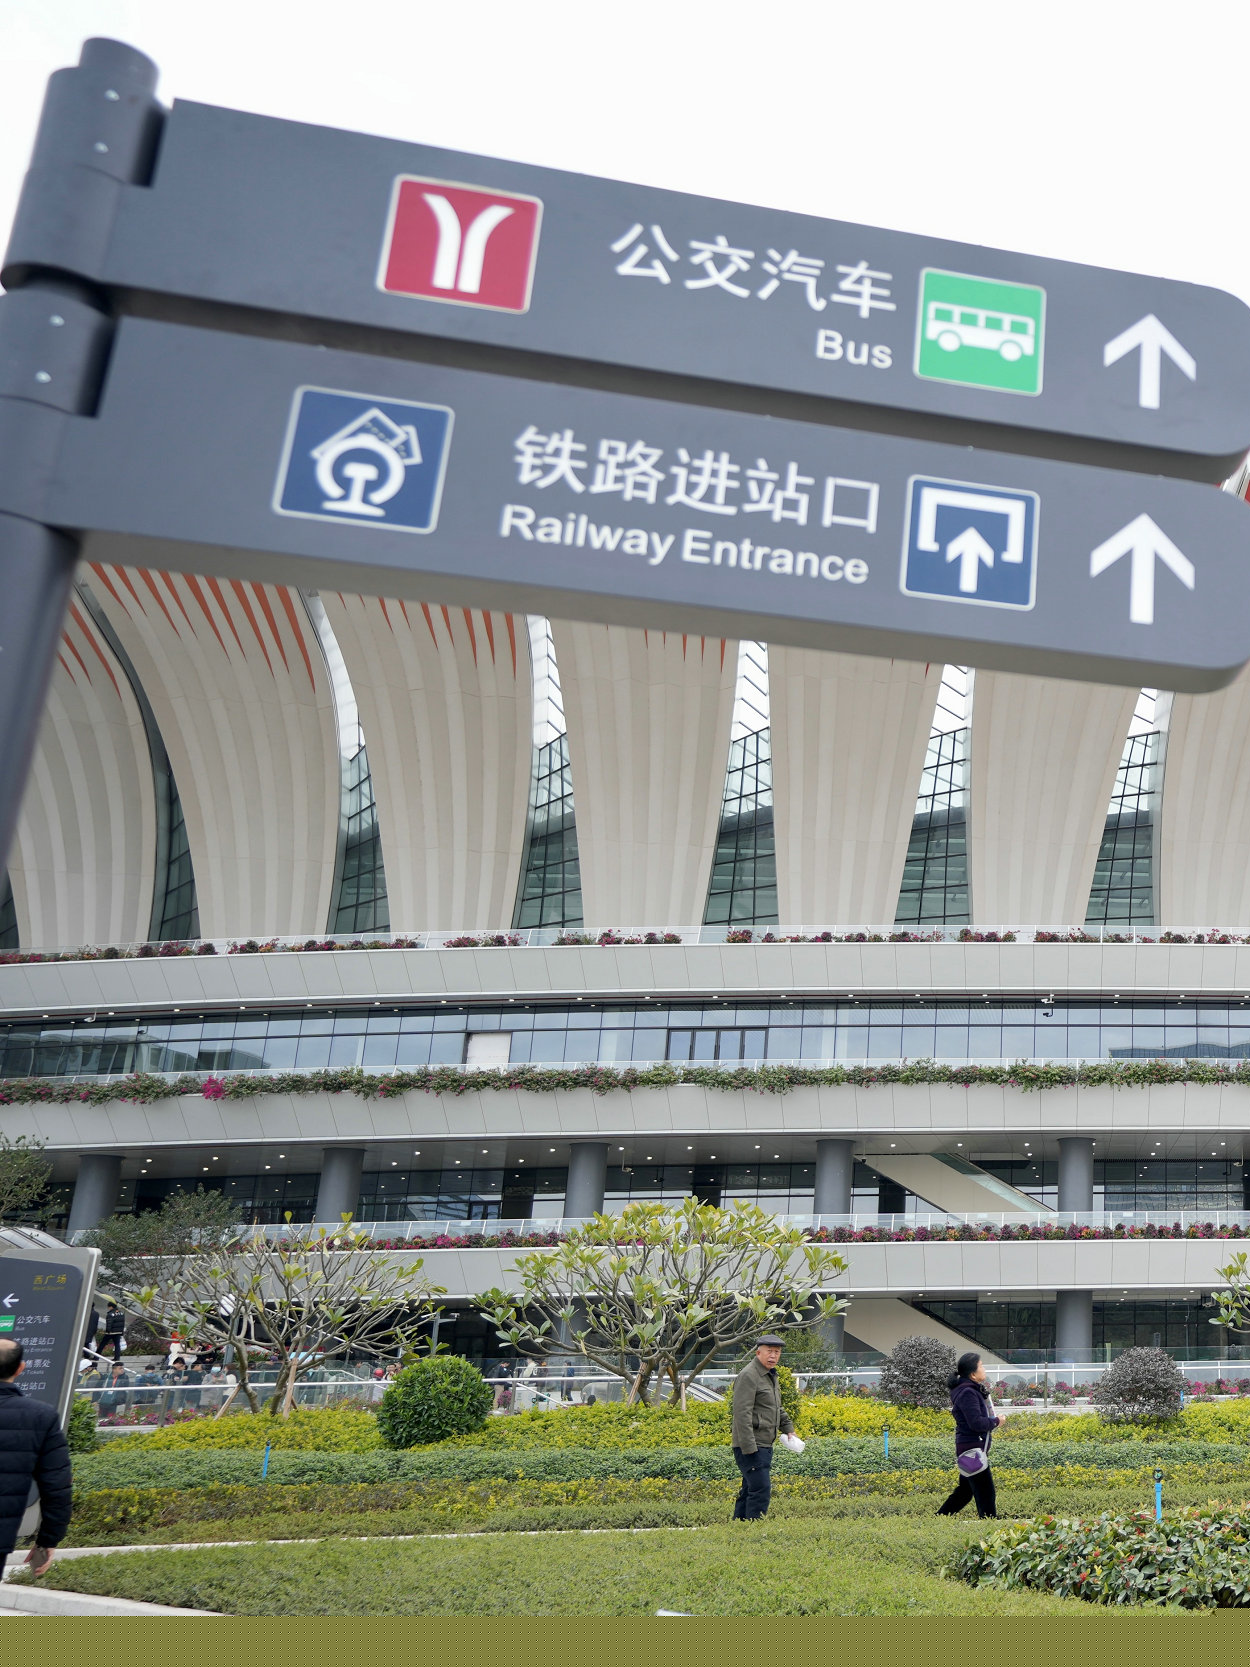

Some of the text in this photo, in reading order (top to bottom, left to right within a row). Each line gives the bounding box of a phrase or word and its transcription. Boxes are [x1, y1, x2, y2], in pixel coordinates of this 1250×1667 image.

[611, 223, 897, 319] 公交汽车
[815, 328, 893, 369] Bus
[513, 425, 881, 534] 铁路进站口
[500, 503, 869, 584] Railway Entrance
[17, 1315, 51, 1324] 公交汽车
[25, 1359, 52, 1368] 售票处
